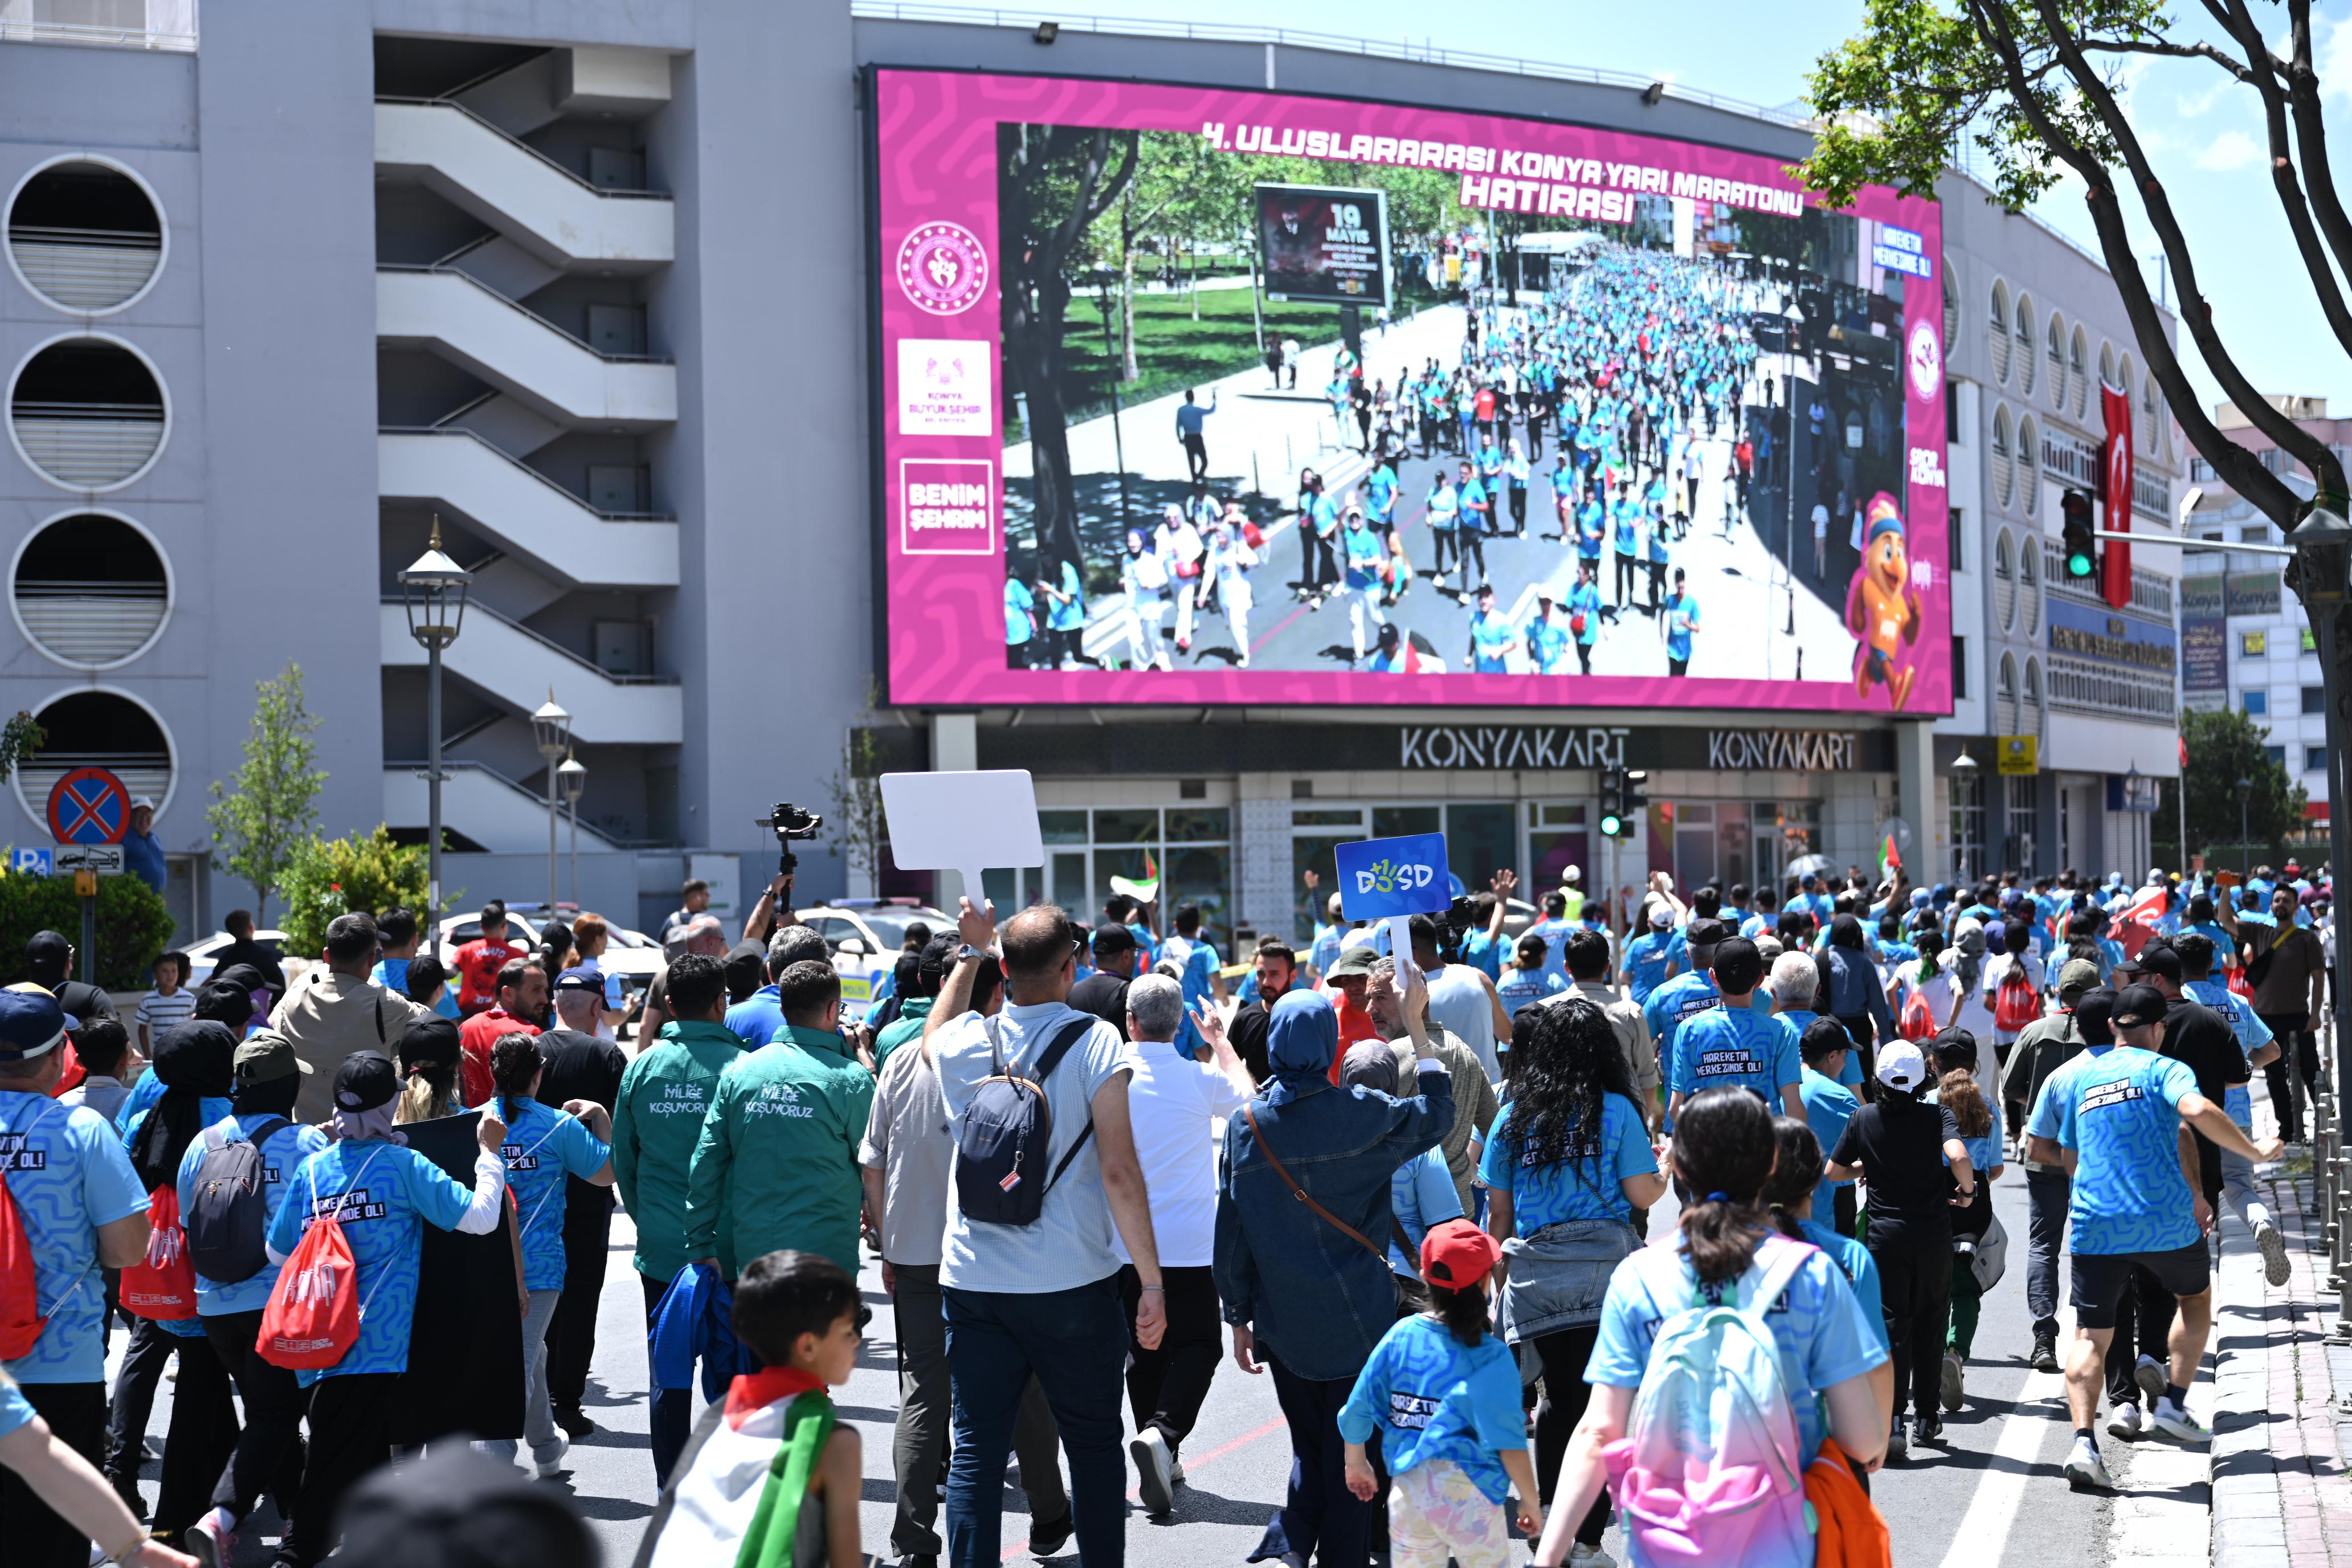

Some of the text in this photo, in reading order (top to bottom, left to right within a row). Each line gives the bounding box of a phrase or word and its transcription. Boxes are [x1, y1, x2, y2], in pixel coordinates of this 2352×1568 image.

[1203, 122, 1804, 217] 4. ULUSLARARASI KONYA YARI MARATONU
[1460, 175, 1634, 223] HATIRASI
[1330, 203, 1361, 228] 19
[928, 392, 963, 401] KONYA
[2228, 589, 2278, 610] Konya
[1402, 728, 1630, 767] KONYAKART
[1709, 731, 1855, 769] KONYAKART
[20, 848, 39, 868] P
[1747, 1061, 1762, 1072] OL!
[664, 1084, 704, 1100] İYİLİĞE
[761, 1083, 800, 1102] İYİLİĞE
[2126, 1087, 2142, 1099] OL!
[650, 1102, 712, 1118] KOŞUYORU
[743, 1101, 814, 1118] KOŞUYORUZ
[21, 1152, 43, 1168] OL!
[519, 1157, 537, 1169] OL!
[365, 1203, 384, 1218] OL!
